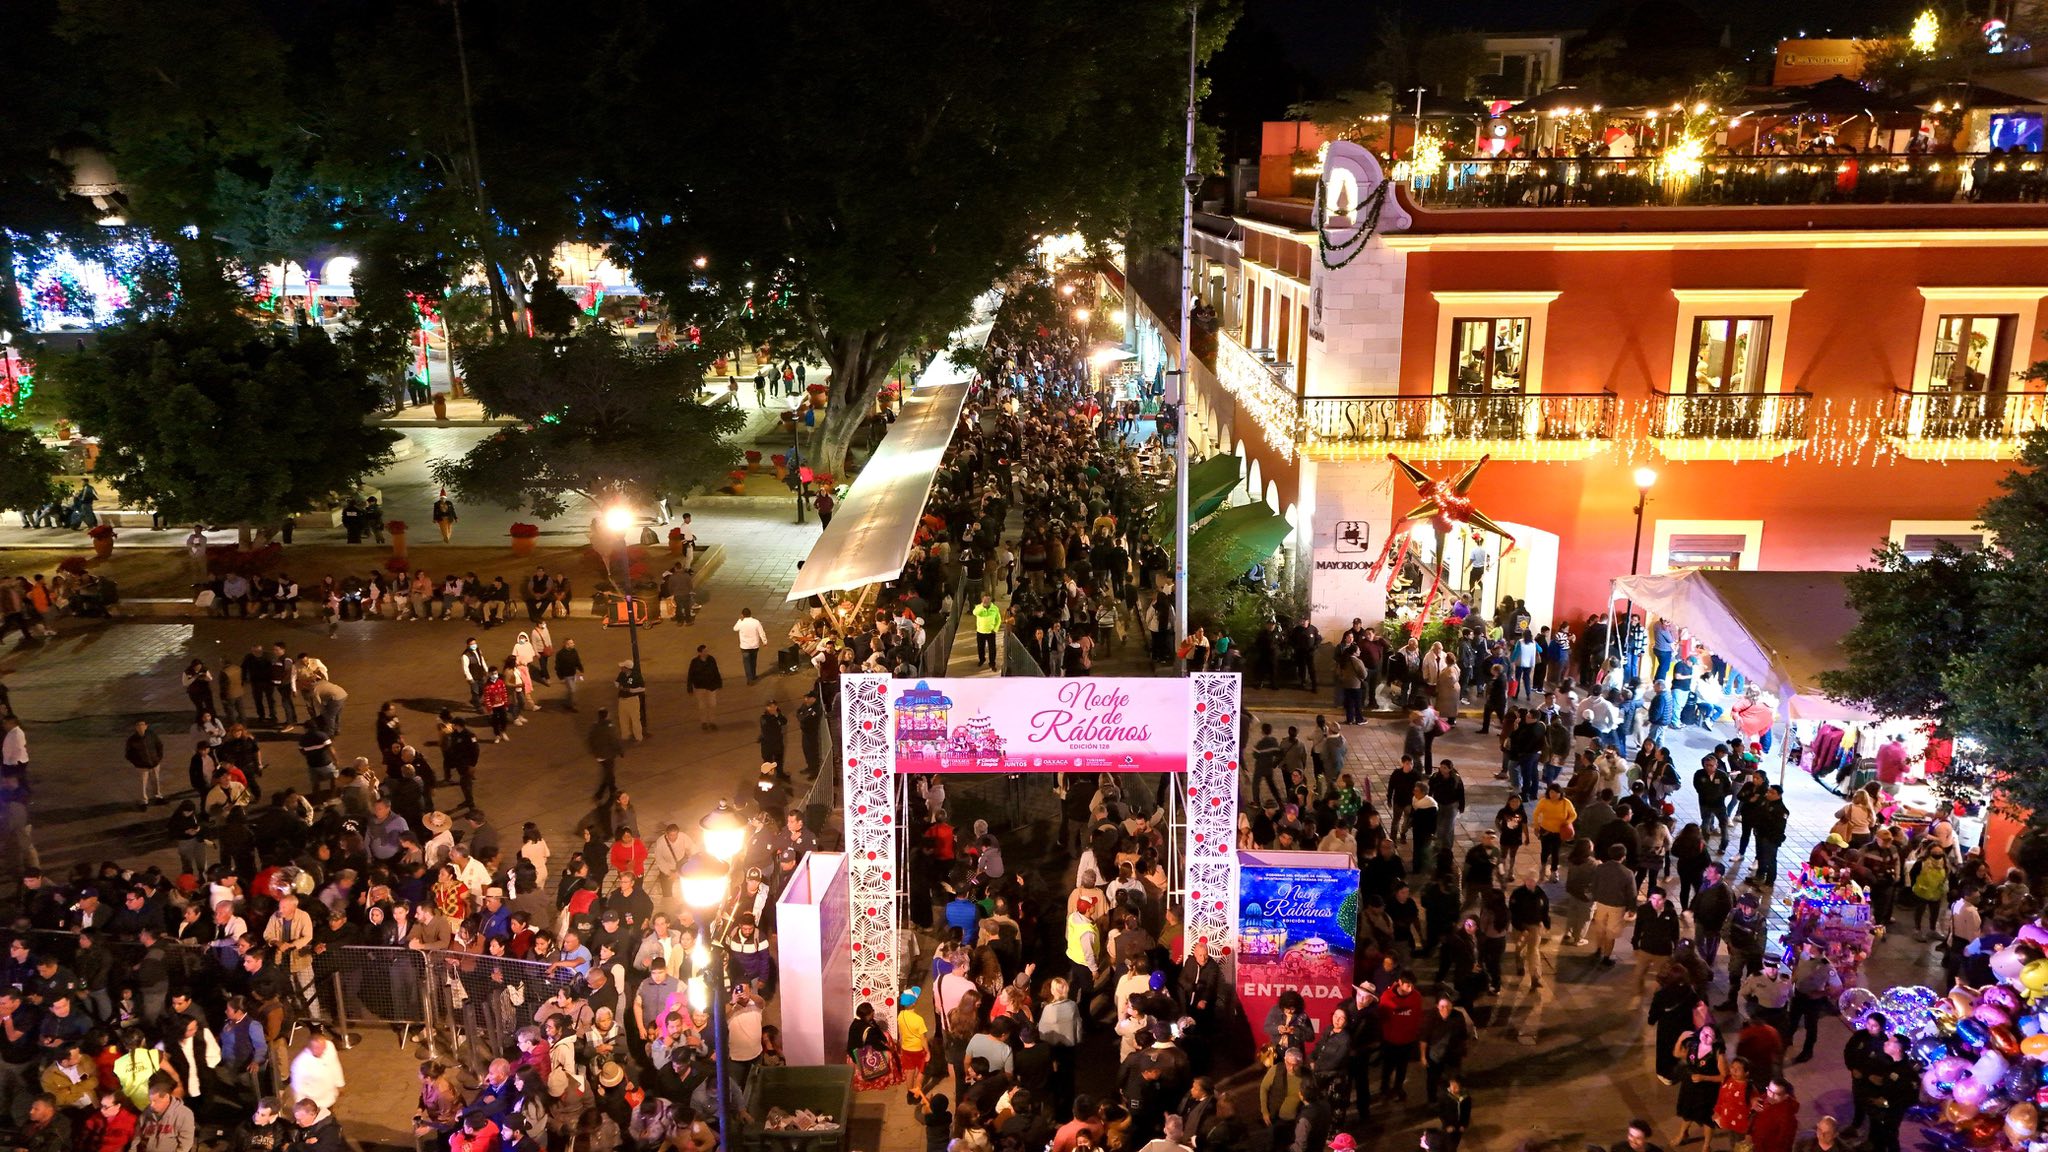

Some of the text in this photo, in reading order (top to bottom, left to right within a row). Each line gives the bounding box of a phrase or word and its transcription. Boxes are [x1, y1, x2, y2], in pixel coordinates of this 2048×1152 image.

[1316, 561, 1375, 570] MAYORDOM
[1058, 681, 1129, 710] Noche
[1101, 705, 1122, 724] de
[1028, 709, 1151, 742] Rábanos
[1277, 883, 1320, 901] Noche
[1263, 898, 1333, 917] Rábanos
[1304, 899, 1317, 909] de
[1244, 983, 1344, 999] ENTRADA
